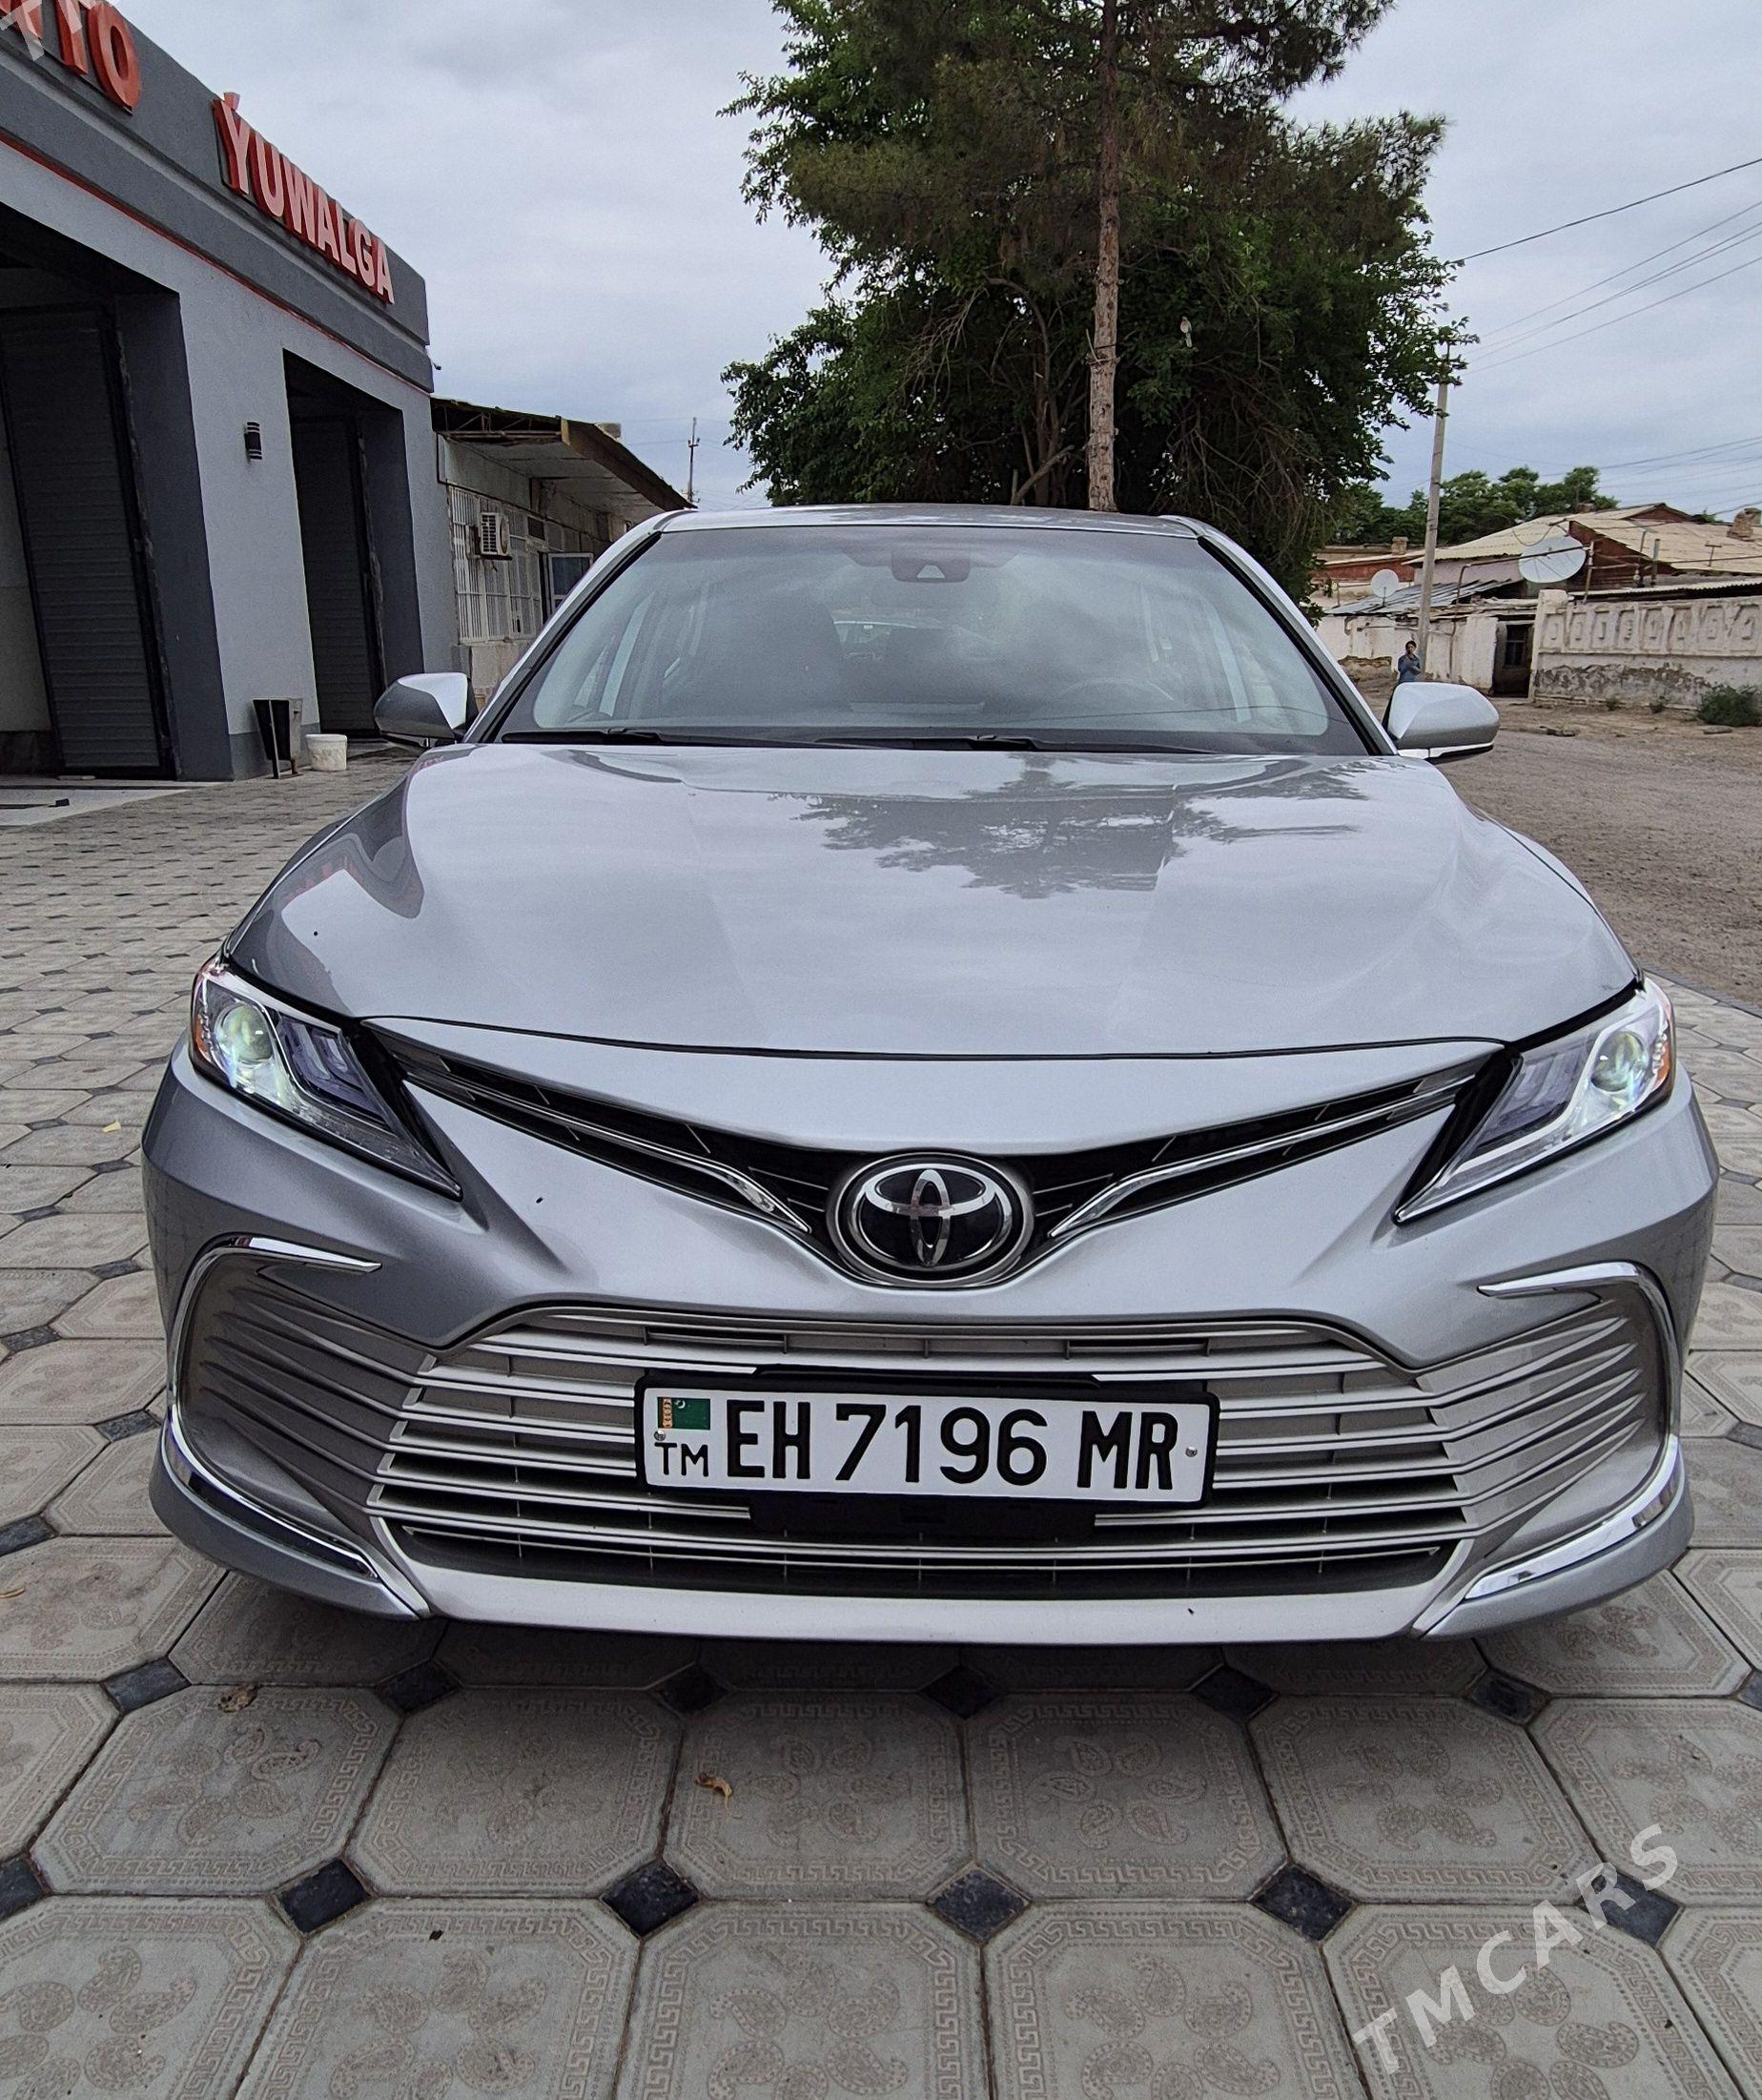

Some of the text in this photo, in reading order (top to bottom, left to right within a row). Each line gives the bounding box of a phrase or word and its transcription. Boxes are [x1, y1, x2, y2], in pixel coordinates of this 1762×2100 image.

[212, 92, 395, 304] ÝUWALGA
[654, 1441, 709, 1478] TM
[727, 1399, 1179, 1491] EH 7196 MR
